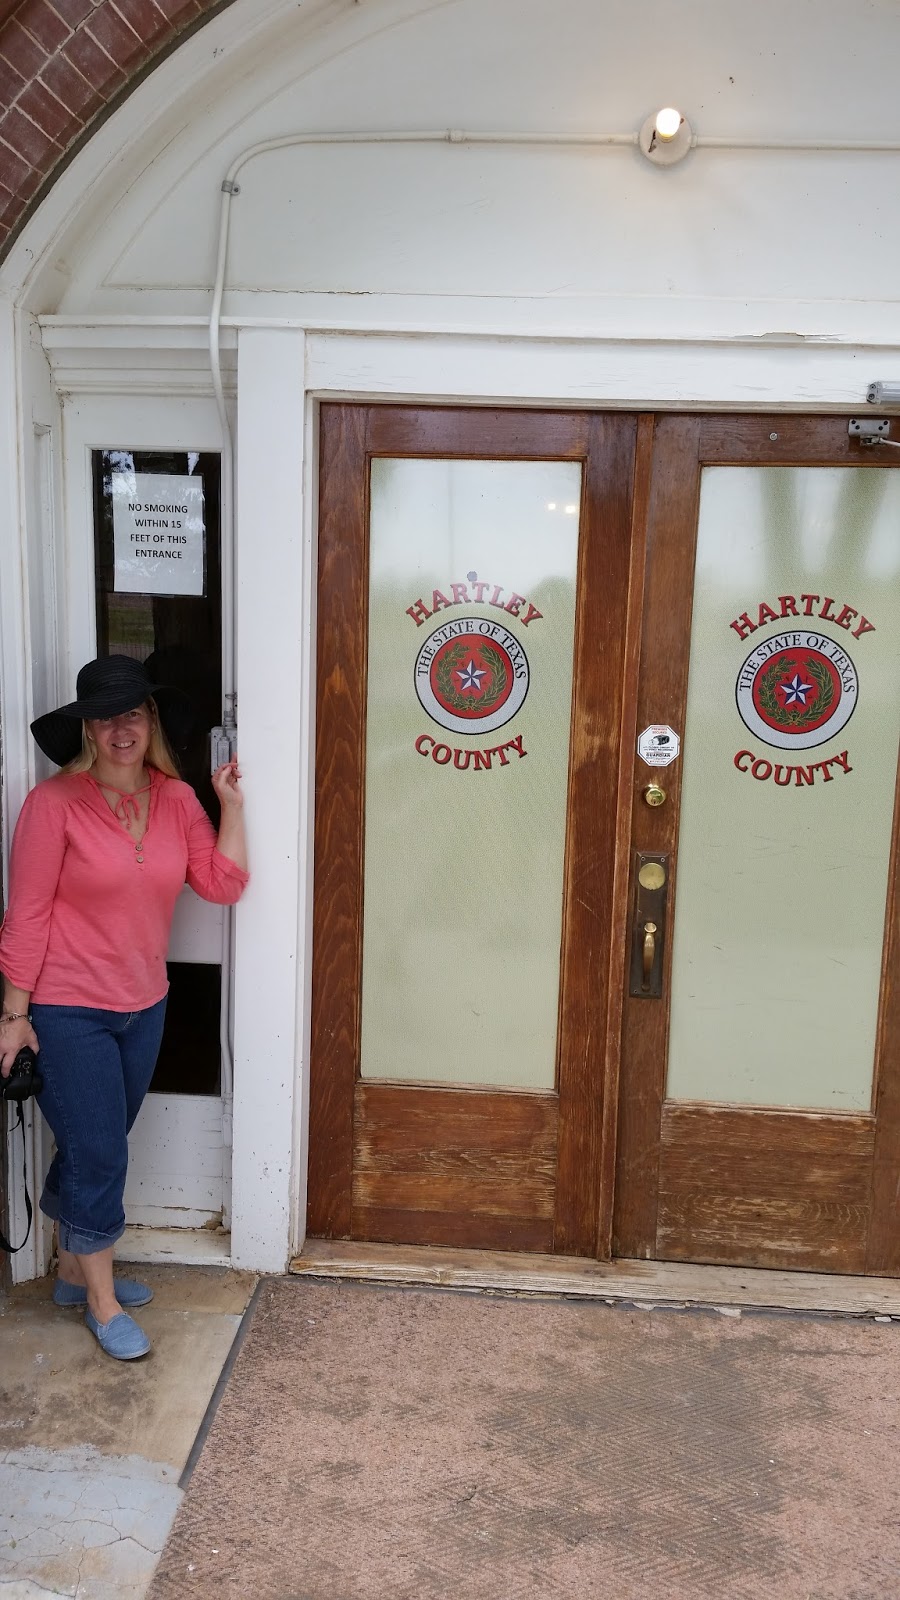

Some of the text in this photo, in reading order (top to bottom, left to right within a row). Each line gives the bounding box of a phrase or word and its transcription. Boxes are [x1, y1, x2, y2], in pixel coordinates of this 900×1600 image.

[128, 503, 188, 513] NO SMOKING
[135, 518, 182, 529] WITHIN 15
[130, 534, 187, 544] FEET OF THIS
[135, 549, 182, 559] ENTRANCE
[406, 582, 544, 627] HARTLEY
[729, 594, 876, 641] HARTLEY
[417, 621, 527, 679] THE STATE OF TEXAS
[739, 634, 855, 693] THE STATE OF TEXAS
[415, 734, 528, 771] COUNTY
[733, 750, 853, 787] COUNTY
